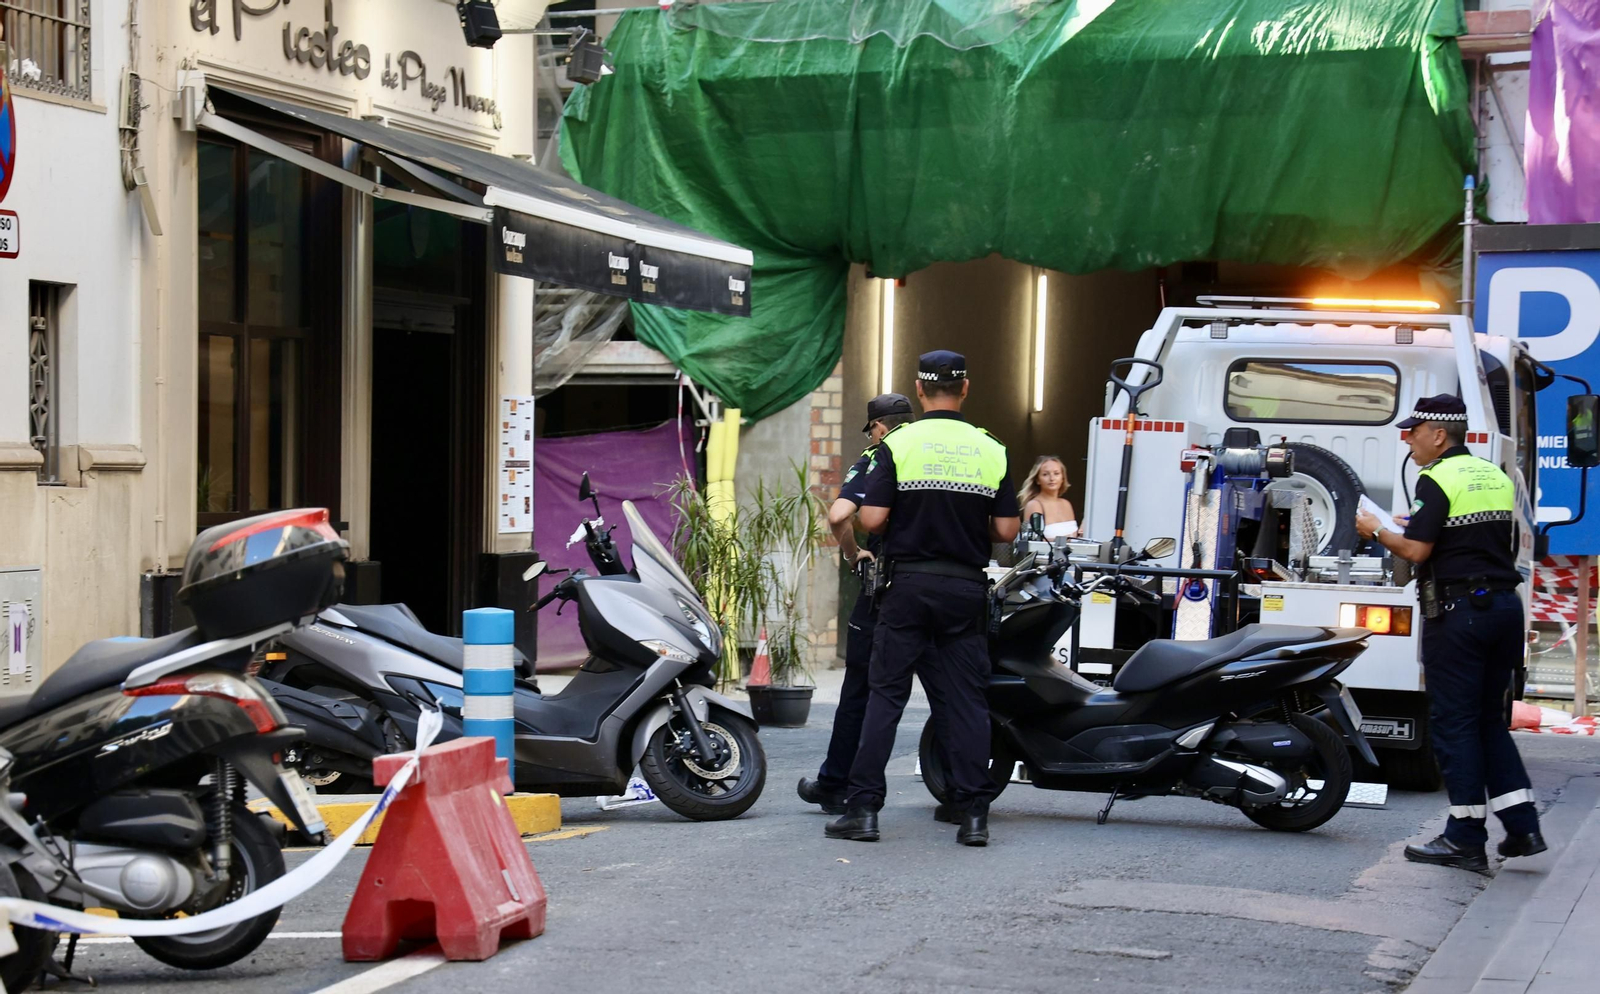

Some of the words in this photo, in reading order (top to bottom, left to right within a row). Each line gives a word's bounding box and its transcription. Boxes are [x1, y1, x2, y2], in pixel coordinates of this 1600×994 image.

[382, 53, 399, 89] de
[1486, 266, 1600, 362] P
[922, 442, 982, 457] POLICIA
[1536, 435, 1568, 449] MIE
[938, 456, 968, 465] LOCAL
[922, 463, 983, 479] SEVILLA
